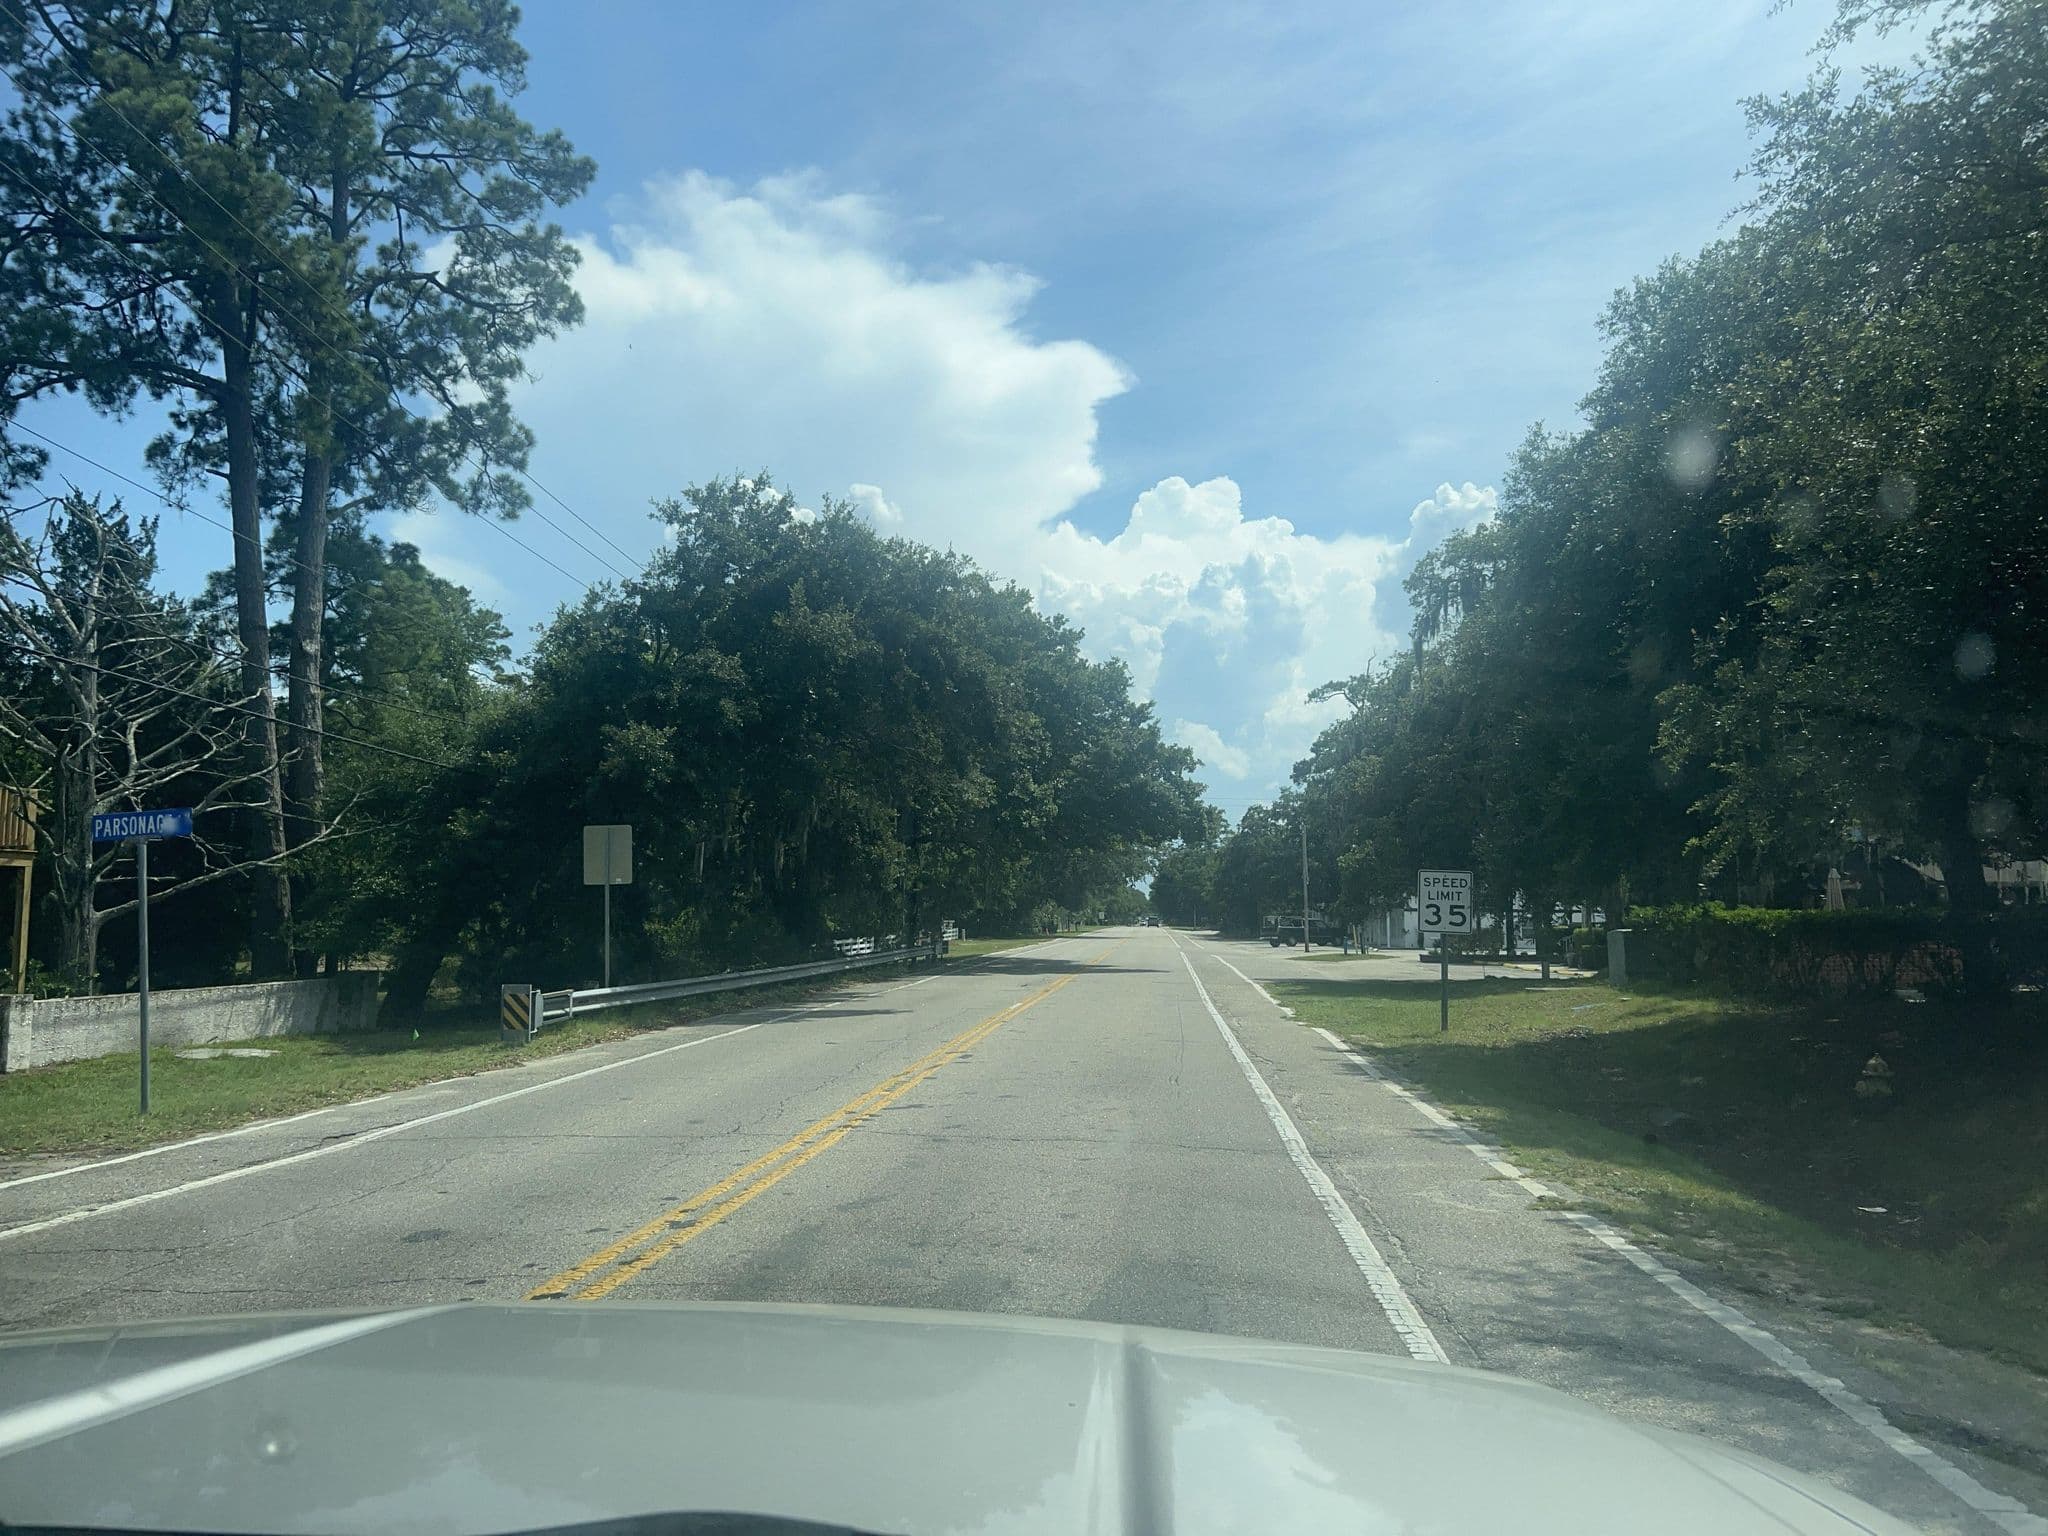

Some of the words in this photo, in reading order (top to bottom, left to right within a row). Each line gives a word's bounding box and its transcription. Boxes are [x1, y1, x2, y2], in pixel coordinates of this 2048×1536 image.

[1423, 877, 1468, 889] SPEED
[1427, 890, 1463, 902] LIMIT
[1424, 904, 1467, 927] 35
